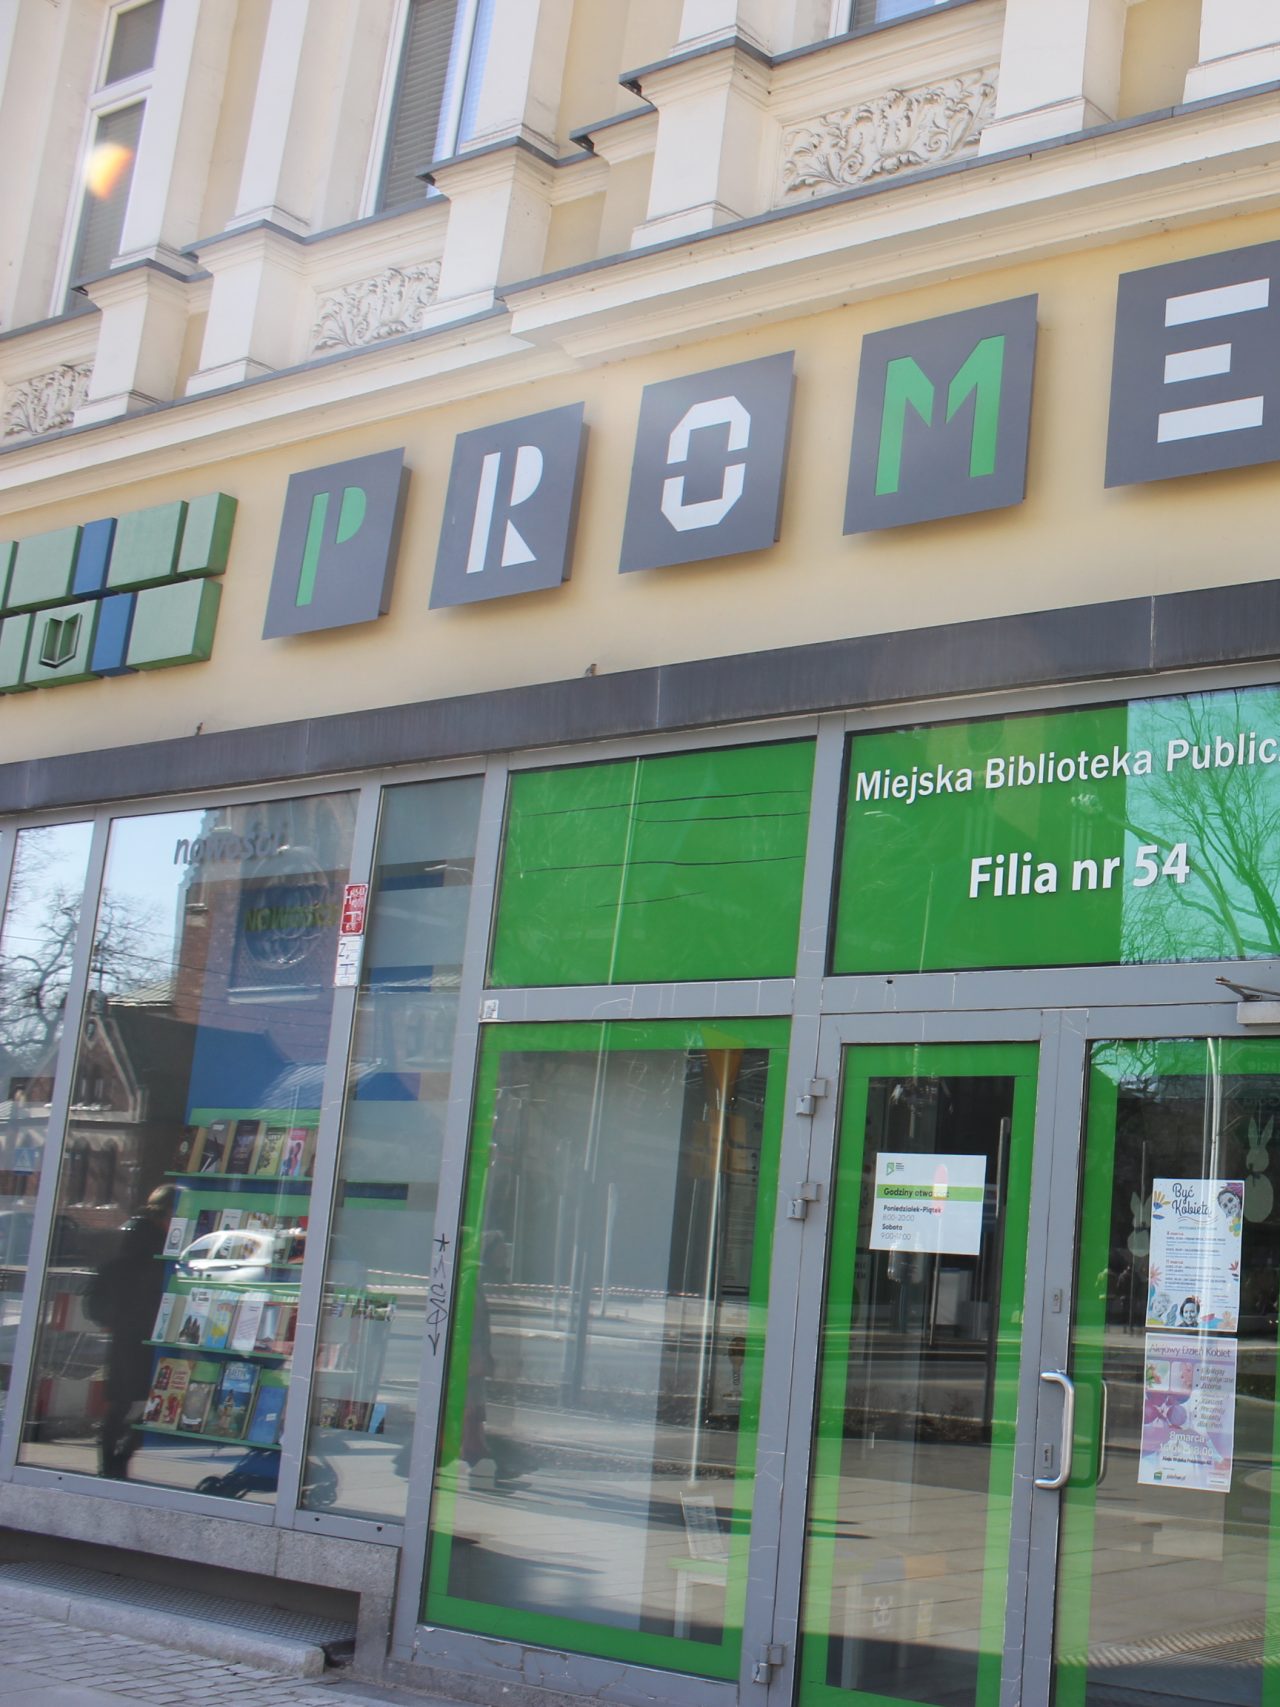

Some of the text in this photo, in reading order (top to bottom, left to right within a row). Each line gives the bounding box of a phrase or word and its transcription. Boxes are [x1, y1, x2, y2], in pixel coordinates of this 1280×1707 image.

[855, 764, 973, 805] Miejska
[985, 745, 1152, 789] Biblioteka
[969, 842, 1190, 899] Filia nr 54
[883, 1187, 913, 1199] Godziny
[1172, 1182, 1195, 1205] Być
[881, 1223, 903, 1231] Sobota
